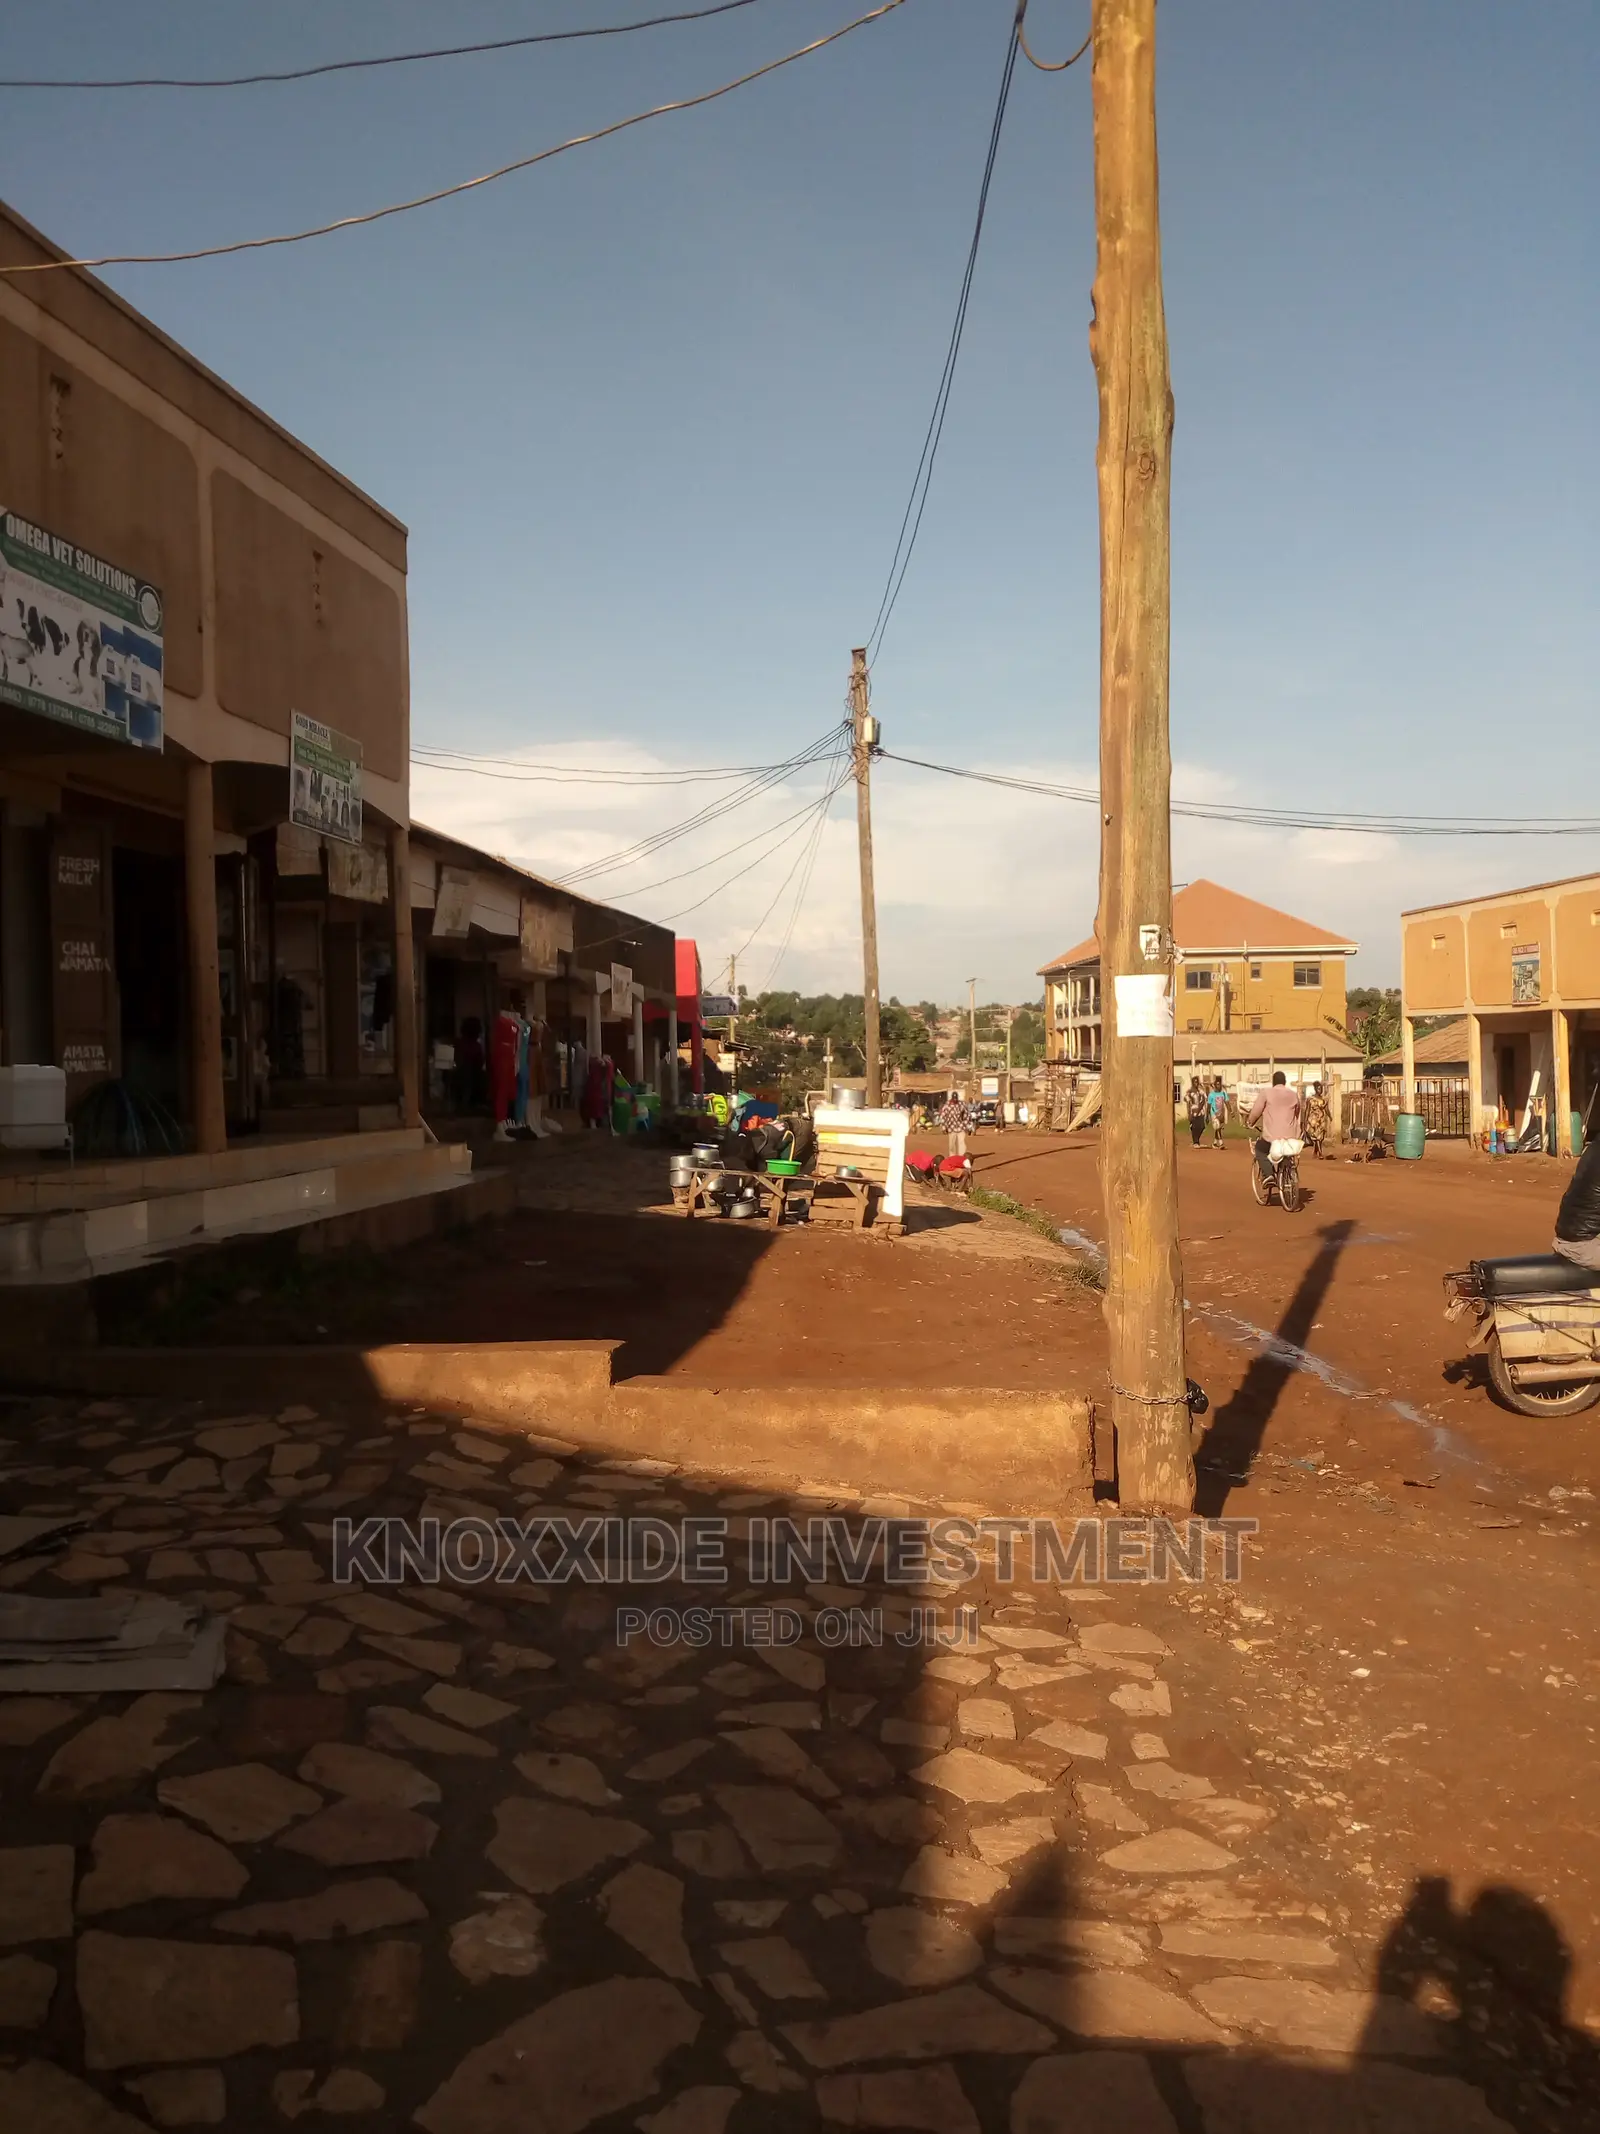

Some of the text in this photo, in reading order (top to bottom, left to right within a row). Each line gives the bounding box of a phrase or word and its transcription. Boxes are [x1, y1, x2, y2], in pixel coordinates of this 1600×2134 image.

[6, 513, 51, 556] OMEGA
[52, 537, 75, 567] VET
[75, 549, 137, 599] SOLUTIONS
[58, 856, 100, 874] FRESH
[58, 871, 93, 886] MILK
[62, 941, 95, 956] CHAI
